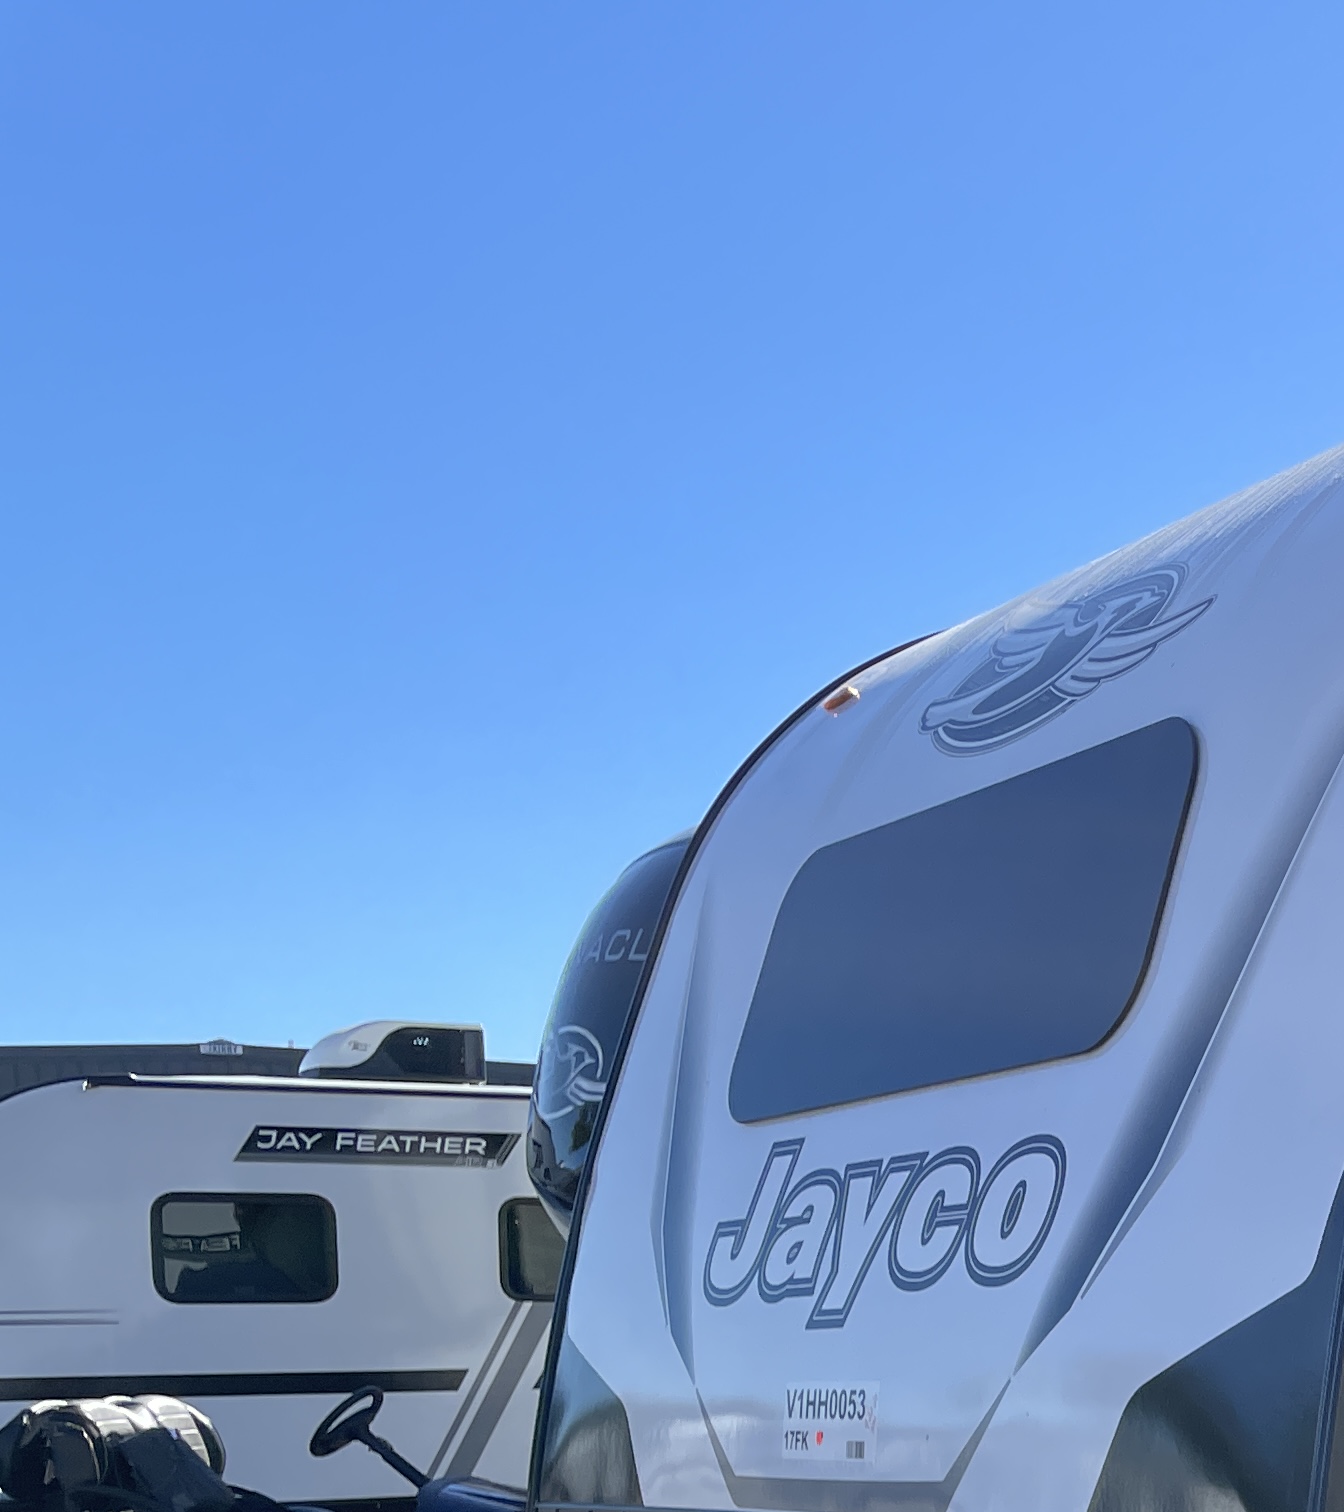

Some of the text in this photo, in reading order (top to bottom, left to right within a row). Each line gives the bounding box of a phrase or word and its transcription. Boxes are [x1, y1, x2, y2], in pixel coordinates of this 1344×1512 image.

[256, 1129, 486, 1155] JAY FEATHER
[703, 1134, 1067, 1330] Jayco
[786, 1388, 866, 1421] V1HH0053
[784, 1430, 809, 1451] 17FK
